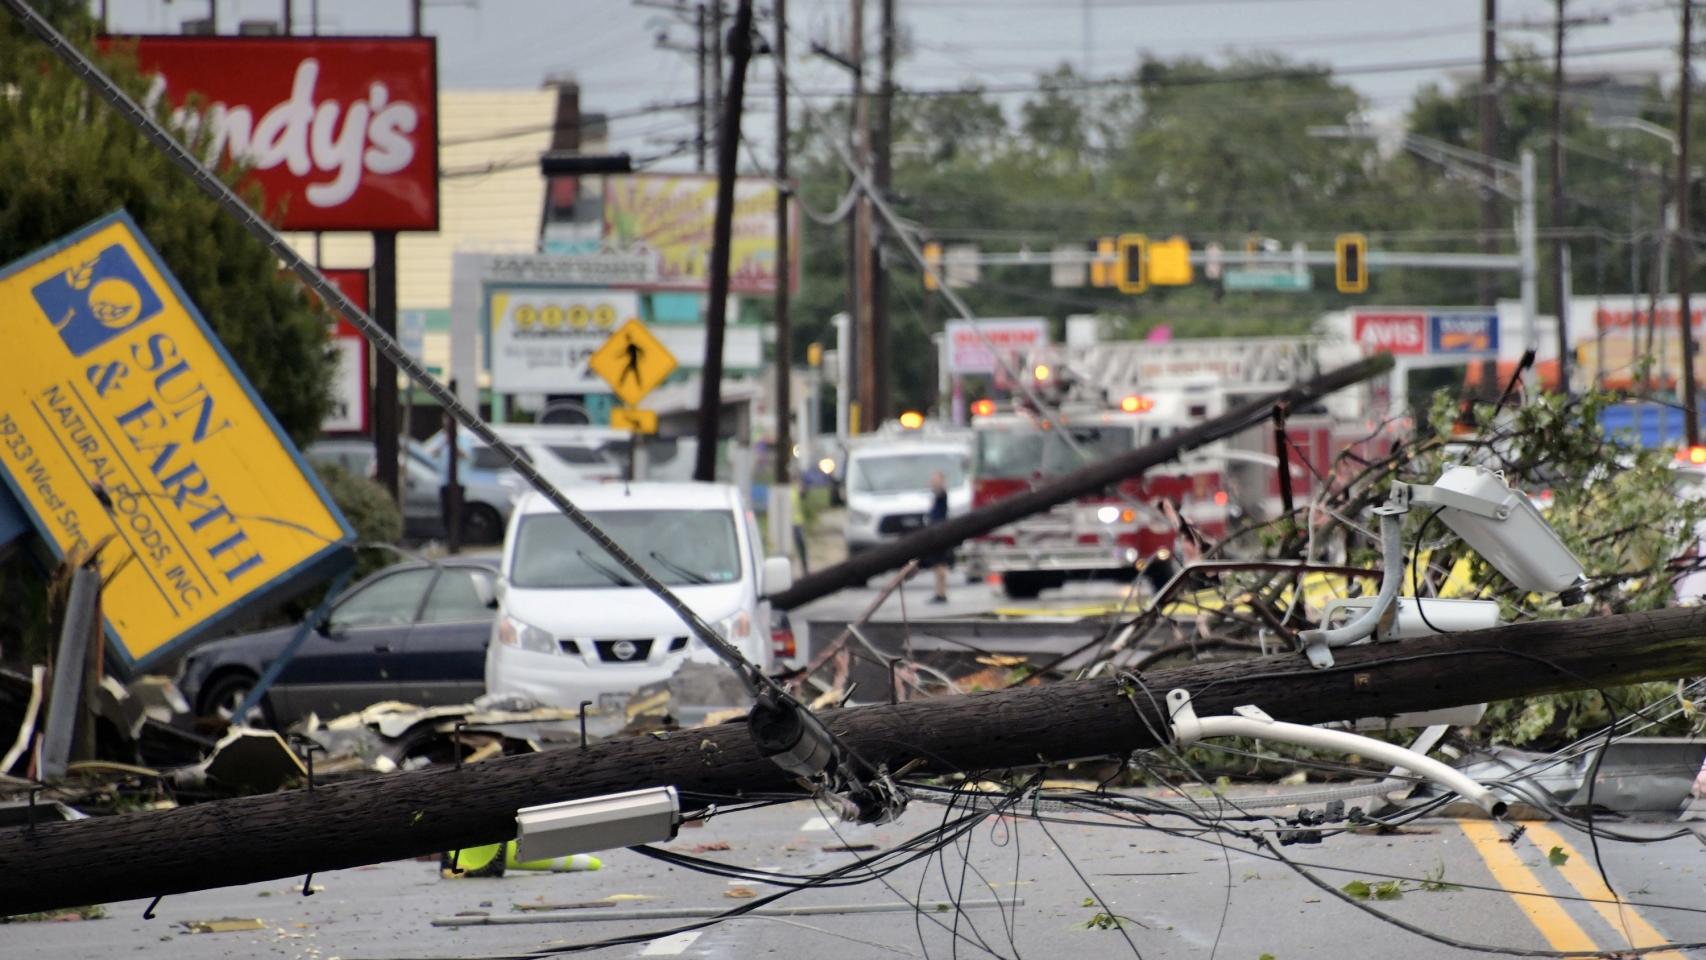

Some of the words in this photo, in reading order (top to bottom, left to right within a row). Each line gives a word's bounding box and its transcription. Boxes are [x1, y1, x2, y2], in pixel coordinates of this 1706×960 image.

[1359, 320, 1418, 347] AVIS
[42, 384, 116, 489] NATURAL
[131, 333, 232, 444] SUN
[26, 458, 66, 513] West
[86, 360, 129, 398] &
[115, 397, 264, 583] EARTH
